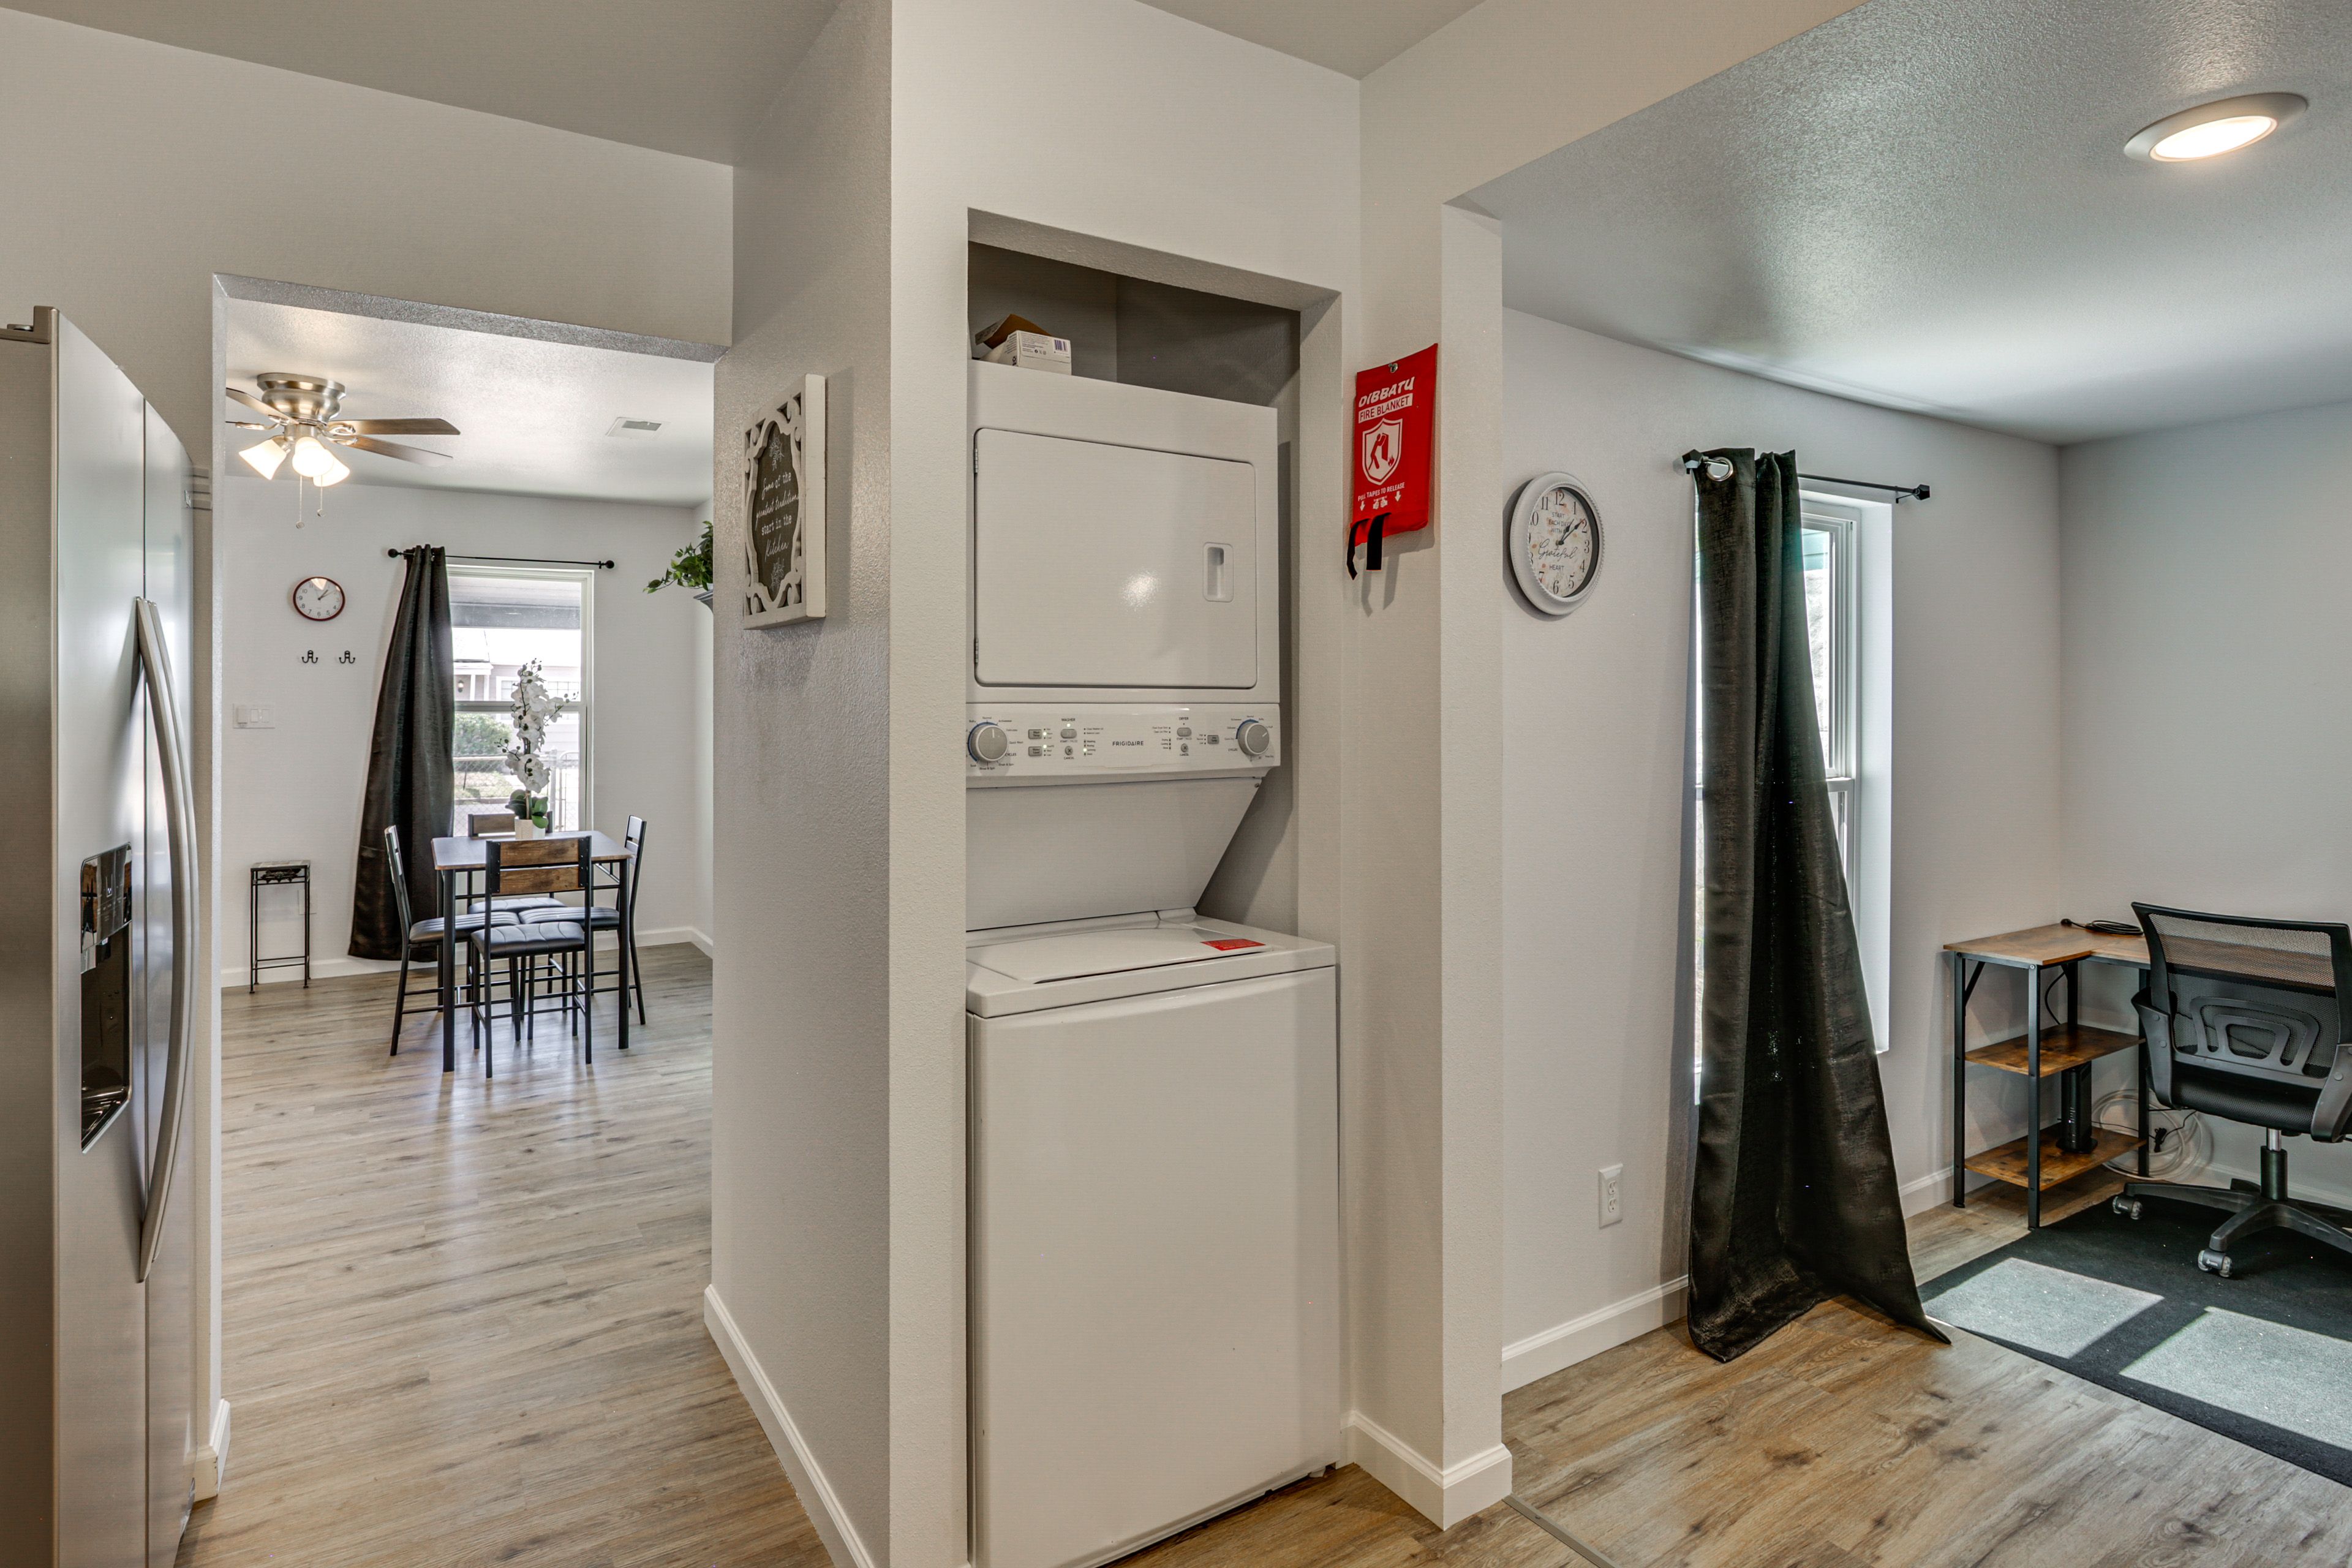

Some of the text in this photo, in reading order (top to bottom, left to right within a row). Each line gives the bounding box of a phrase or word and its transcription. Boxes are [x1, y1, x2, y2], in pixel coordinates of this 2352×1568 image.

[1359, 377, 1415, 407] DIBBATU
[1360, 396, 1409, 421] FIRE BLANKET
[783, 472, 791, 484] the
[1366, 489, 1380, 498] TAPES
[1387, 482, 1405, 492] RELEASE
[1541, 496, 1549, 510] 11
[1555, 492, 1564, 507] 12
[761, 514, 792, 536] start in the
[1581, 519, 1588, 533] 2
[765, 533, 789, 562] Kitchen
[1538, 538, 1578, 562] Grateful
[1584, 540, 1590, 554] 3
[1580, 559, 1586, 573] 4
[1539, 571, 1545, 584] 7
[1568, 575, 1575, 589] 5
[1553, 580, 1559, 595] 6
